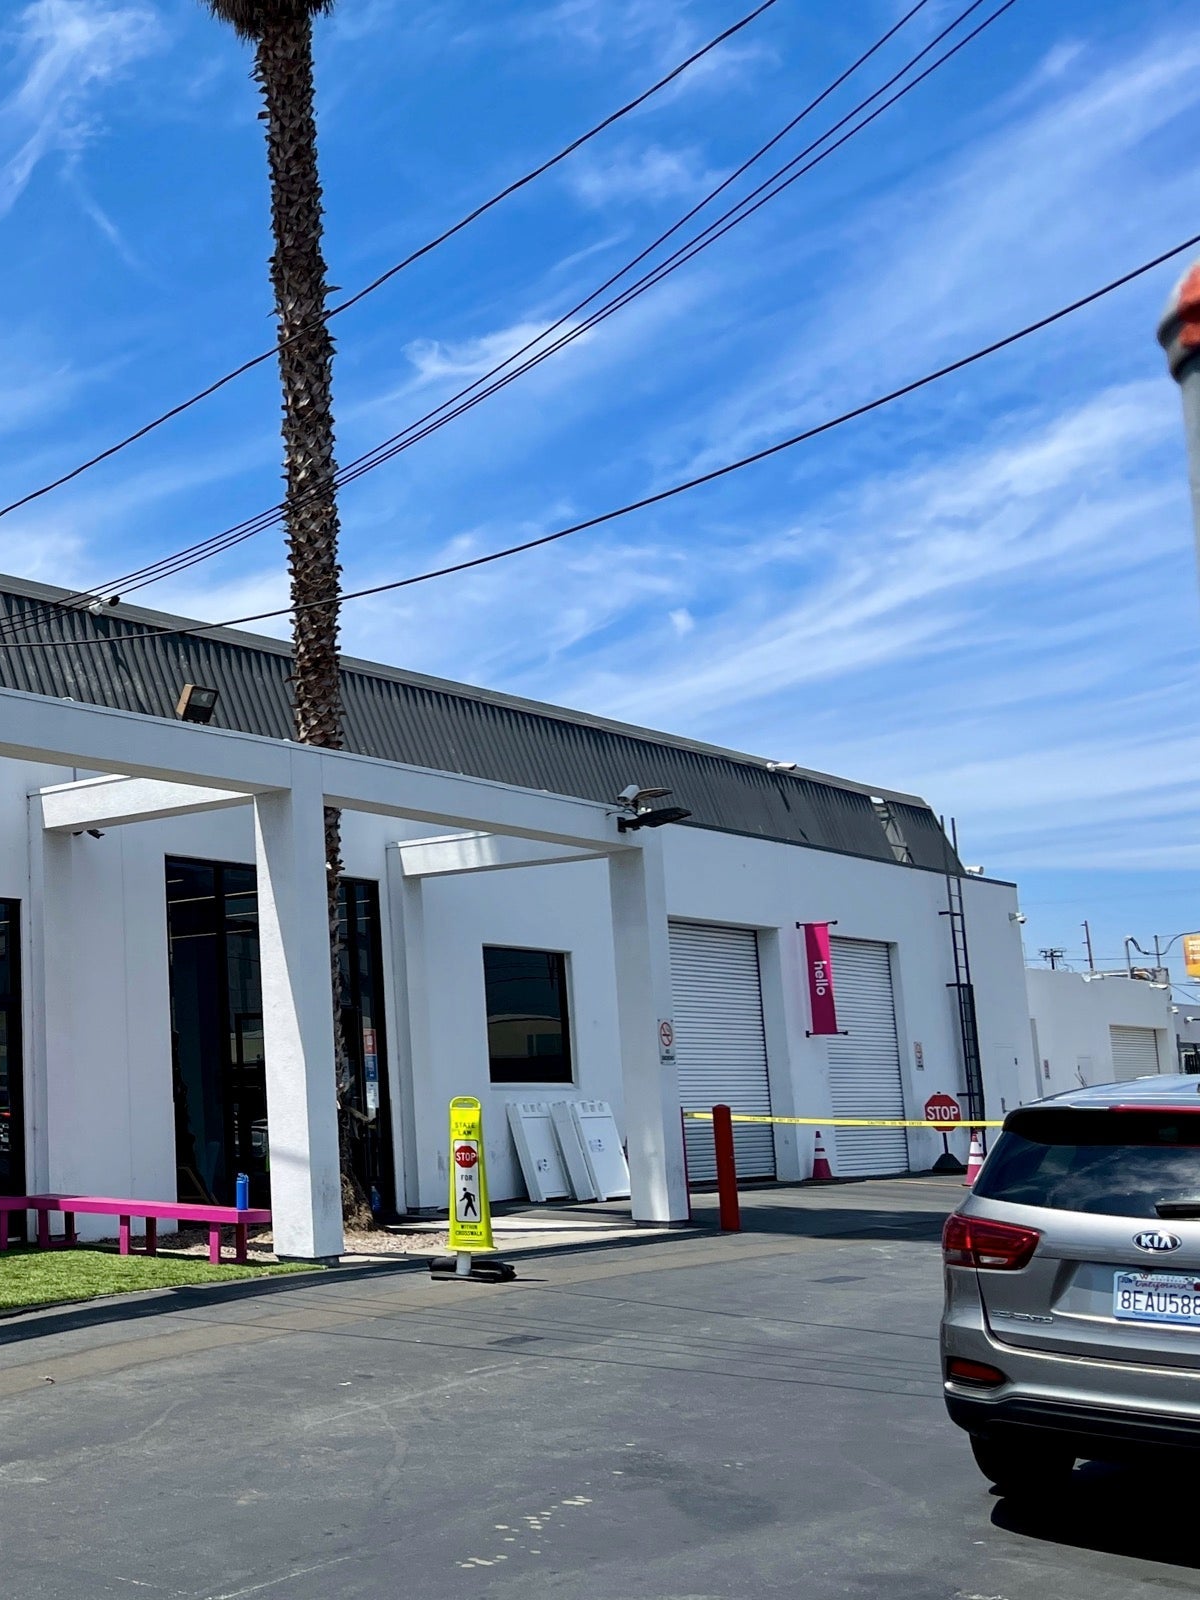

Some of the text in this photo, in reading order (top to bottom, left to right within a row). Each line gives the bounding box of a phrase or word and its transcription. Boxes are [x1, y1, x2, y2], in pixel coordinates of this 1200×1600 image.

[814, 961, 829, 996] hello
[926, 1106, 959, 1121] STOP
[456, 1152, 476, 1162] STOP
[1141, 1234, 1173, 1249] KIA
[1121, 1289, 1200, 1316] 8EAU588
